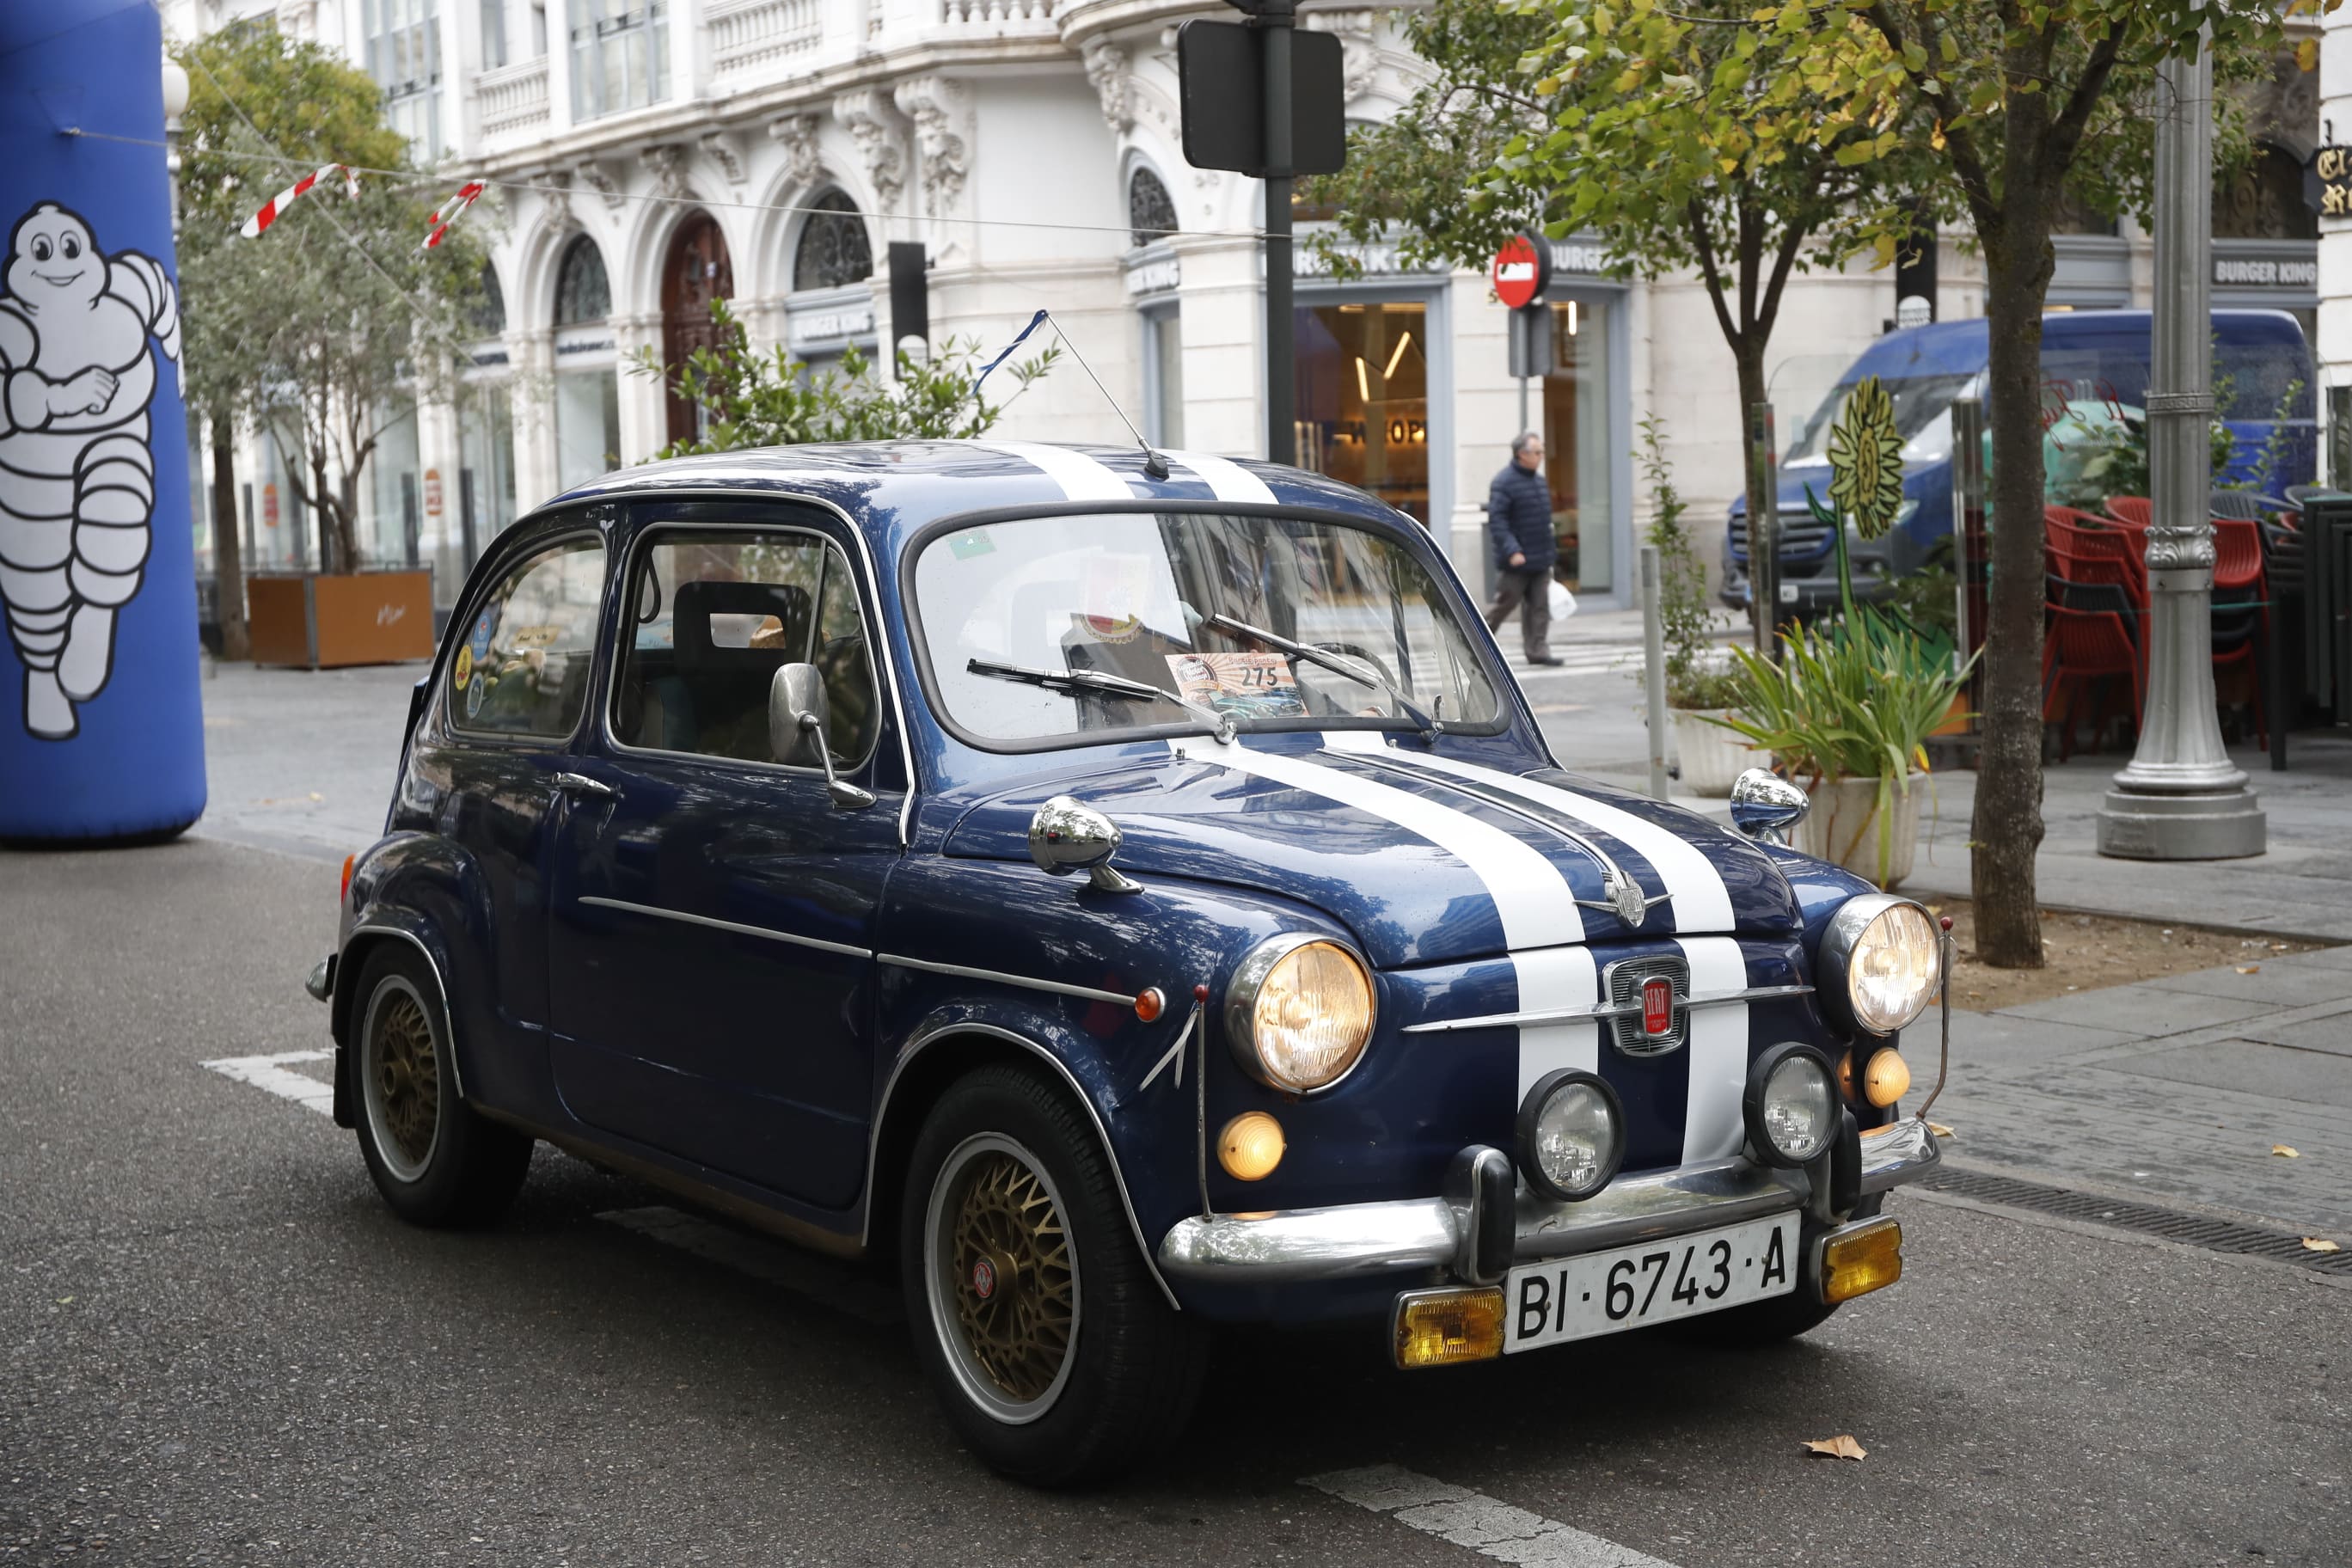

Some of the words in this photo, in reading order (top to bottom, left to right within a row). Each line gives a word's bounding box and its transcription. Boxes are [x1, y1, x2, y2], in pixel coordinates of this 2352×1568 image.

[2216, 260, 2276, 282] BURGER
[2278, 261, 2316, 282] KING
[1240, 667, 1279, 686] 275
[1645, 987, 1666, 1016] SEAT
